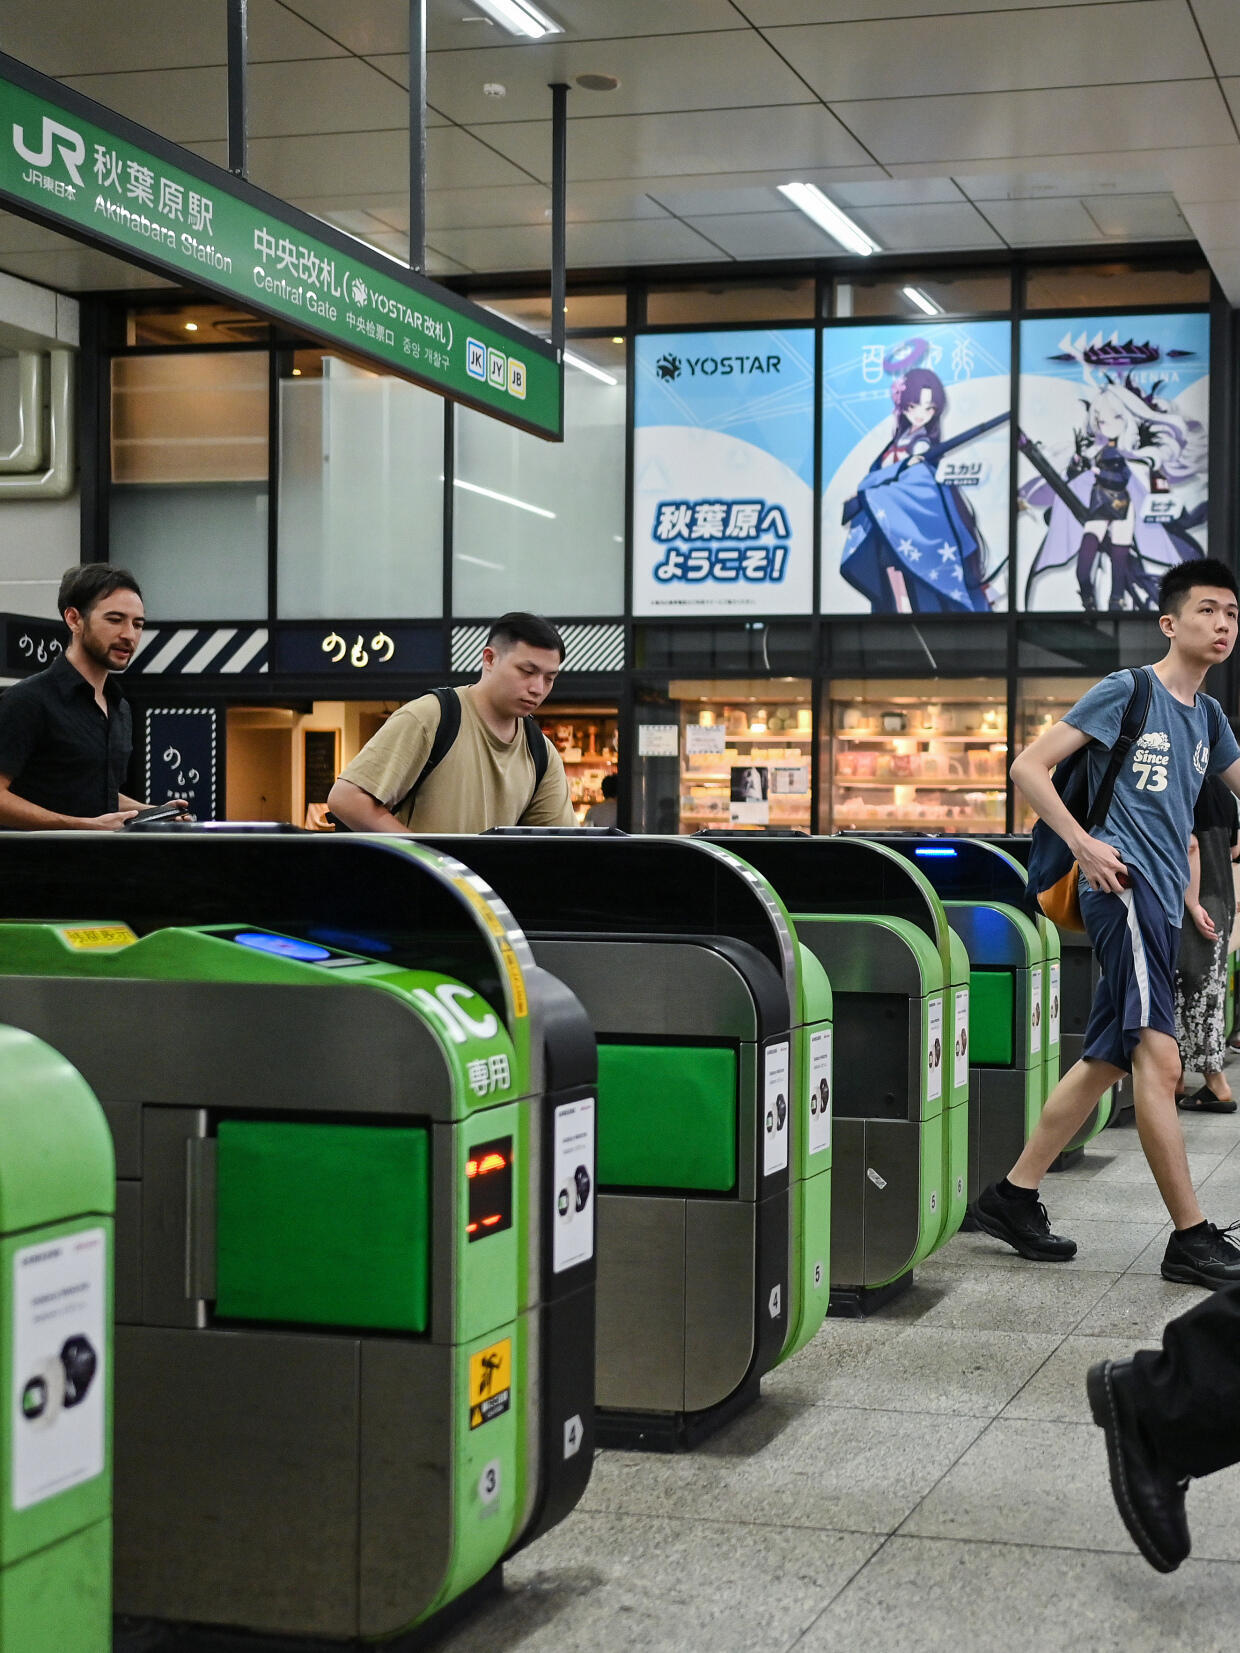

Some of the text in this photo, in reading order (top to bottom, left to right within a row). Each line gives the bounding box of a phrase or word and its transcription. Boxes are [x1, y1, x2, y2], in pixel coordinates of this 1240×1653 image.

[13, 116, 85, 187] JR
[22, 168, 76, 201] JR東日本
[93, 144, 213, 236] 秋葉原駅
[94, 194, 232, 274] Akihabara Station
[253, 266, 338, 322] Central Gate
[402, 336, 421, 359] 중앙
[470, 350, 483, 369] JK
[491, 360, 503, 377] JY
[510, 370, 522, 387] JB
[686, 354, 782, 377] YOSTAR
[943, 461, 983, 476] ユカリ
[656, 502, 787, 540] 秋葉原へ
[656, 548, 787, 580] ようこそ!
[19, 633, 63, 664] のもの
[321, 631, 395, 668] のもの
[1133, 748, 1170, 766] Since
[1132, 762, 1168, 792] 73
[412, 983, 499, 1044] IC
[466, 1053, 511, 1097] 専用
[568, 1423, 577, 1446] 4
[485, 1467, 496, 1494] 3
